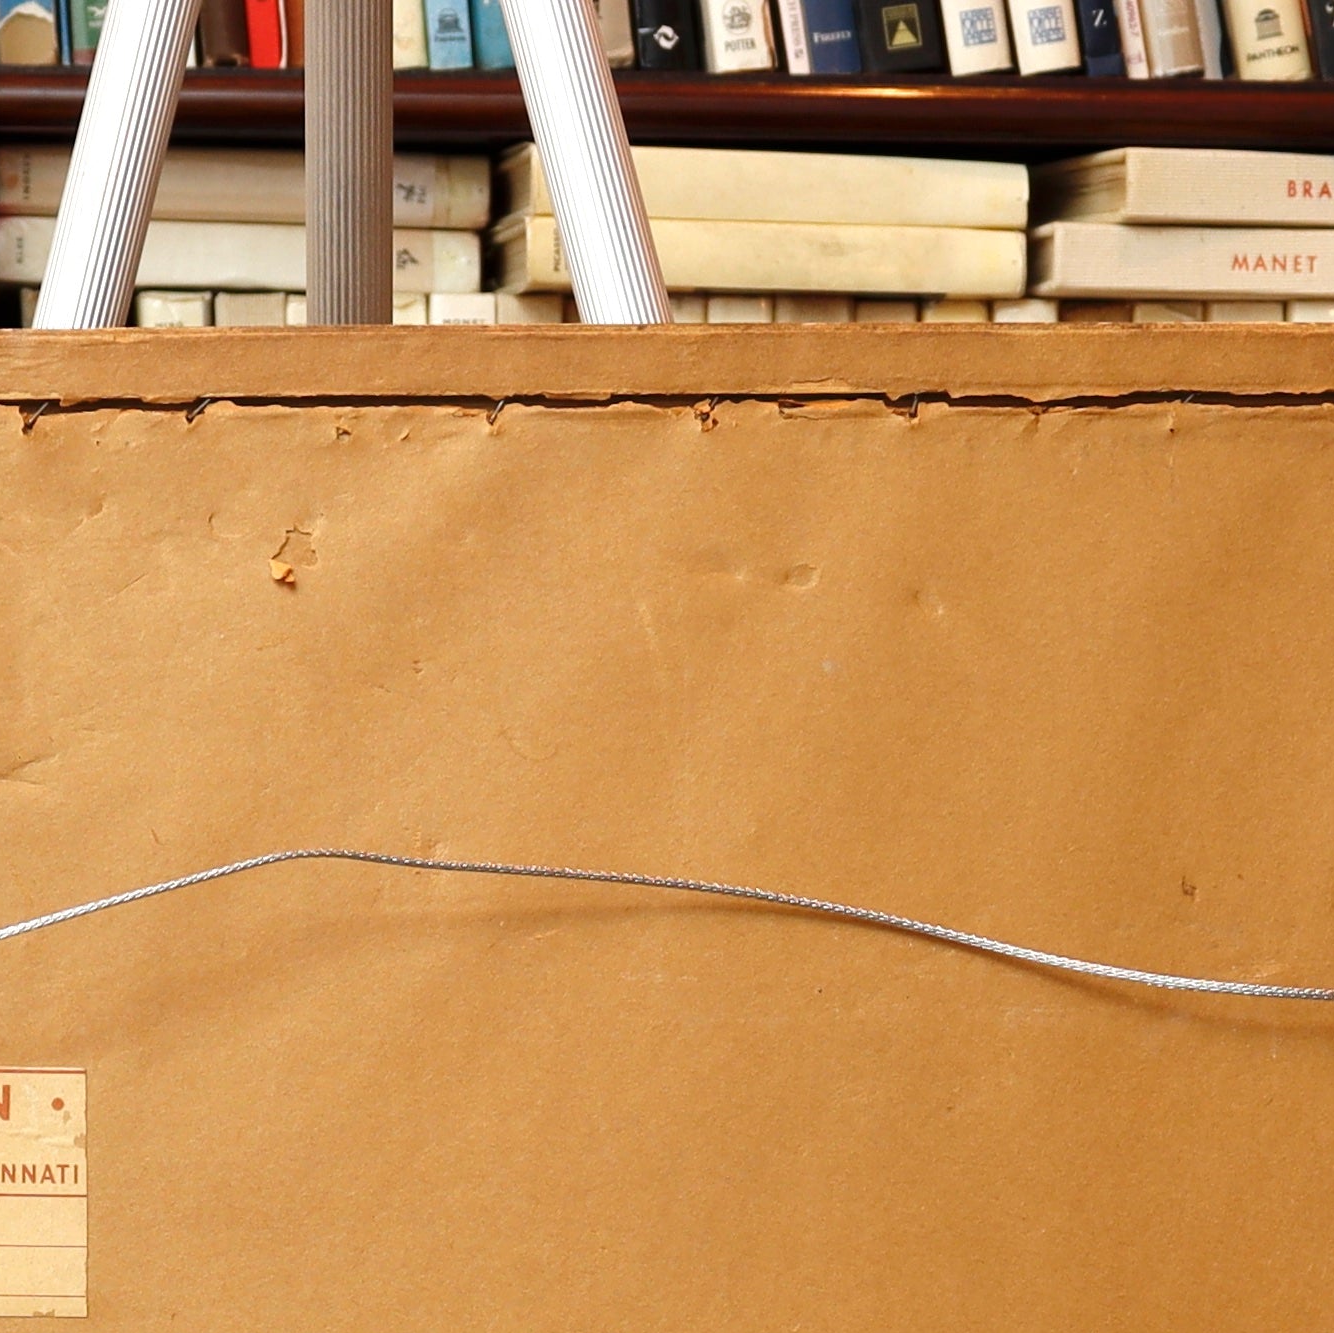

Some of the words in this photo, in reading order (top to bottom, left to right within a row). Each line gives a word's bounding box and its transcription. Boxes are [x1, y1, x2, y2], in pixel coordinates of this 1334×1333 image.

[723, 38, 756, 53] POTTER
[1246, 44, 1300, 63] PANTHEON
[1230, 252, 1319, 274] MANET
